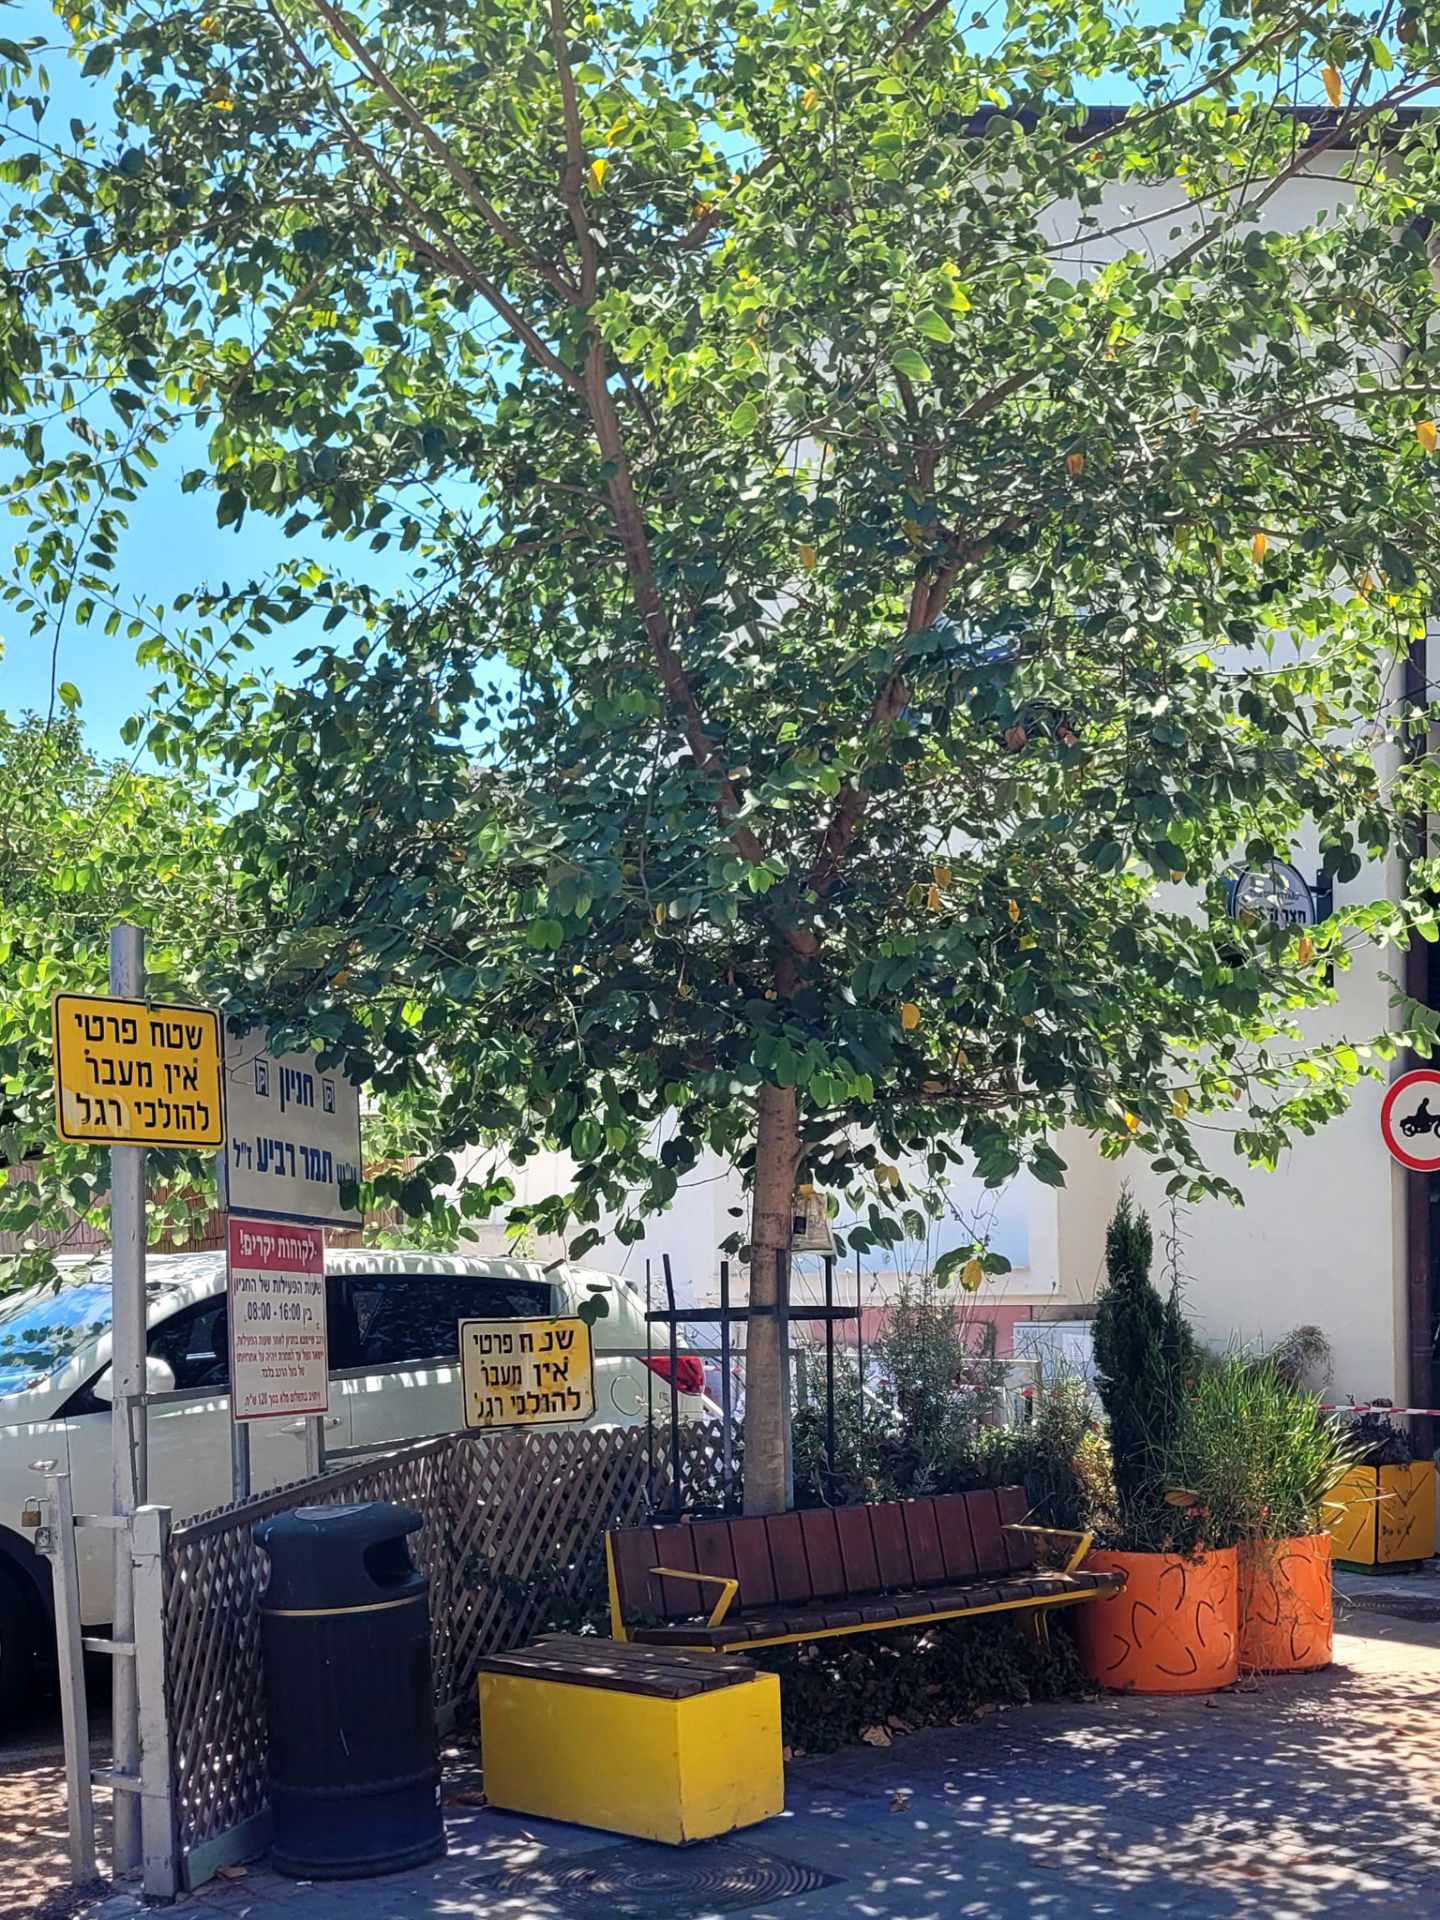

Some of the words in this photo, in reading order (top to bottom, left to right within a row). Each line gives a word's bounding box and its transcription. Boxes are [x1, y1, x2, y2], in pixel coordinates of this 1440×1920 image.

[74, 1013, 137, 1045] פרטי
[150, 1021, 203, 1050] שטח
[85, 1056, 153, 1088] מעבר
[164, 1063, 198, 1094] אין
[279, 1066, 314, 1113] חניון
[76, 1092, 122, 1127] רגל
[134, 1098, 209, 1131] להולכי
[256, 1136, 296, 1178] רביע
[299, 1144, 334, 1184] תמר
[239, 1229, 275, 1264] יקרים!
[278, 1232, 315, 1267] לקוחות
[234, 1276, 257, 1297] החניון
[259, 1273, 270, 1293] של
[272, 1274, 303, 1294] הפעילות
[279, 1302, 301, 1321] 16:00
[473, 1333, 513, 1354] פרטי
[480, 1364, 522, 1387] מעבר
[533, 1361, 568, 1387] אין
[510, 1386, 581, 1415] להולכי
